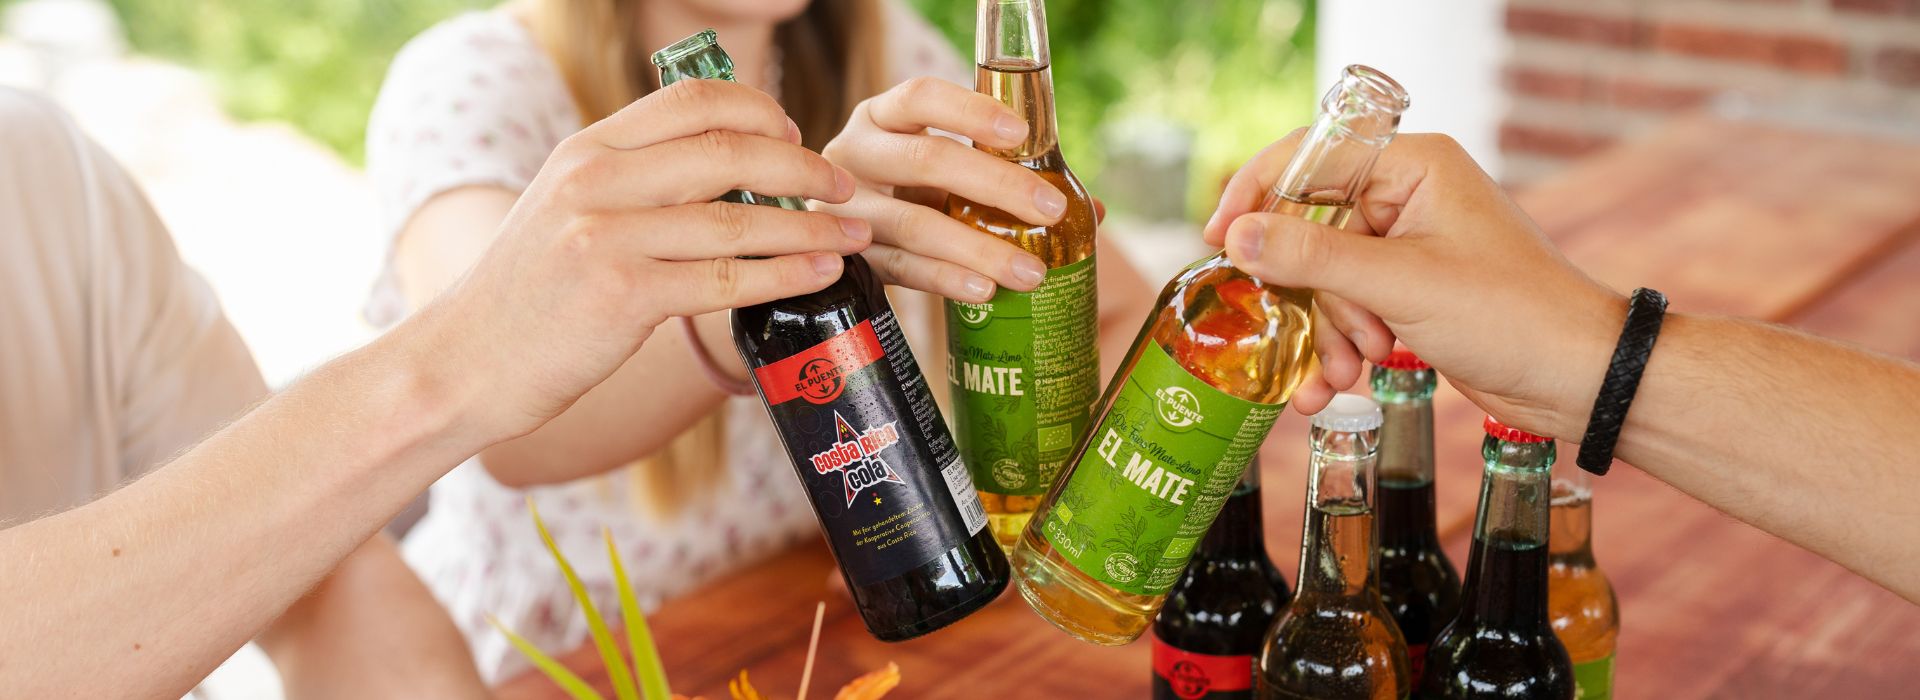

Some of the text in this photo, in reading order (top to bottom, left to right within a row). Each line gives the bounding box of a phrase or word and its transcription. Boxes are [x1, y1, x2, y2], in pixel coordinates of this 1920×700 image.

[962, 302, 994, 312] PUENTE
[795, 382, 807, 392] EL
[963, 362, 1024, 396] MATE
[1155, 388, 1204, 424] EL PUENTE
[813, 443, 860, 473] costa
[1096, 428, 1123, 468] EL
[1122, 452, 1194, 506] MATE
[1148, 442, 1201, 476] Mate-Limo
[848, 460, 888, 490] cola
[864, 529, 896, 542] Kooperative
[886, 537, 904, 546] Costa
[904, 530, 917, 539] Rica
[1054, 528, 1083, 558] 330ml
